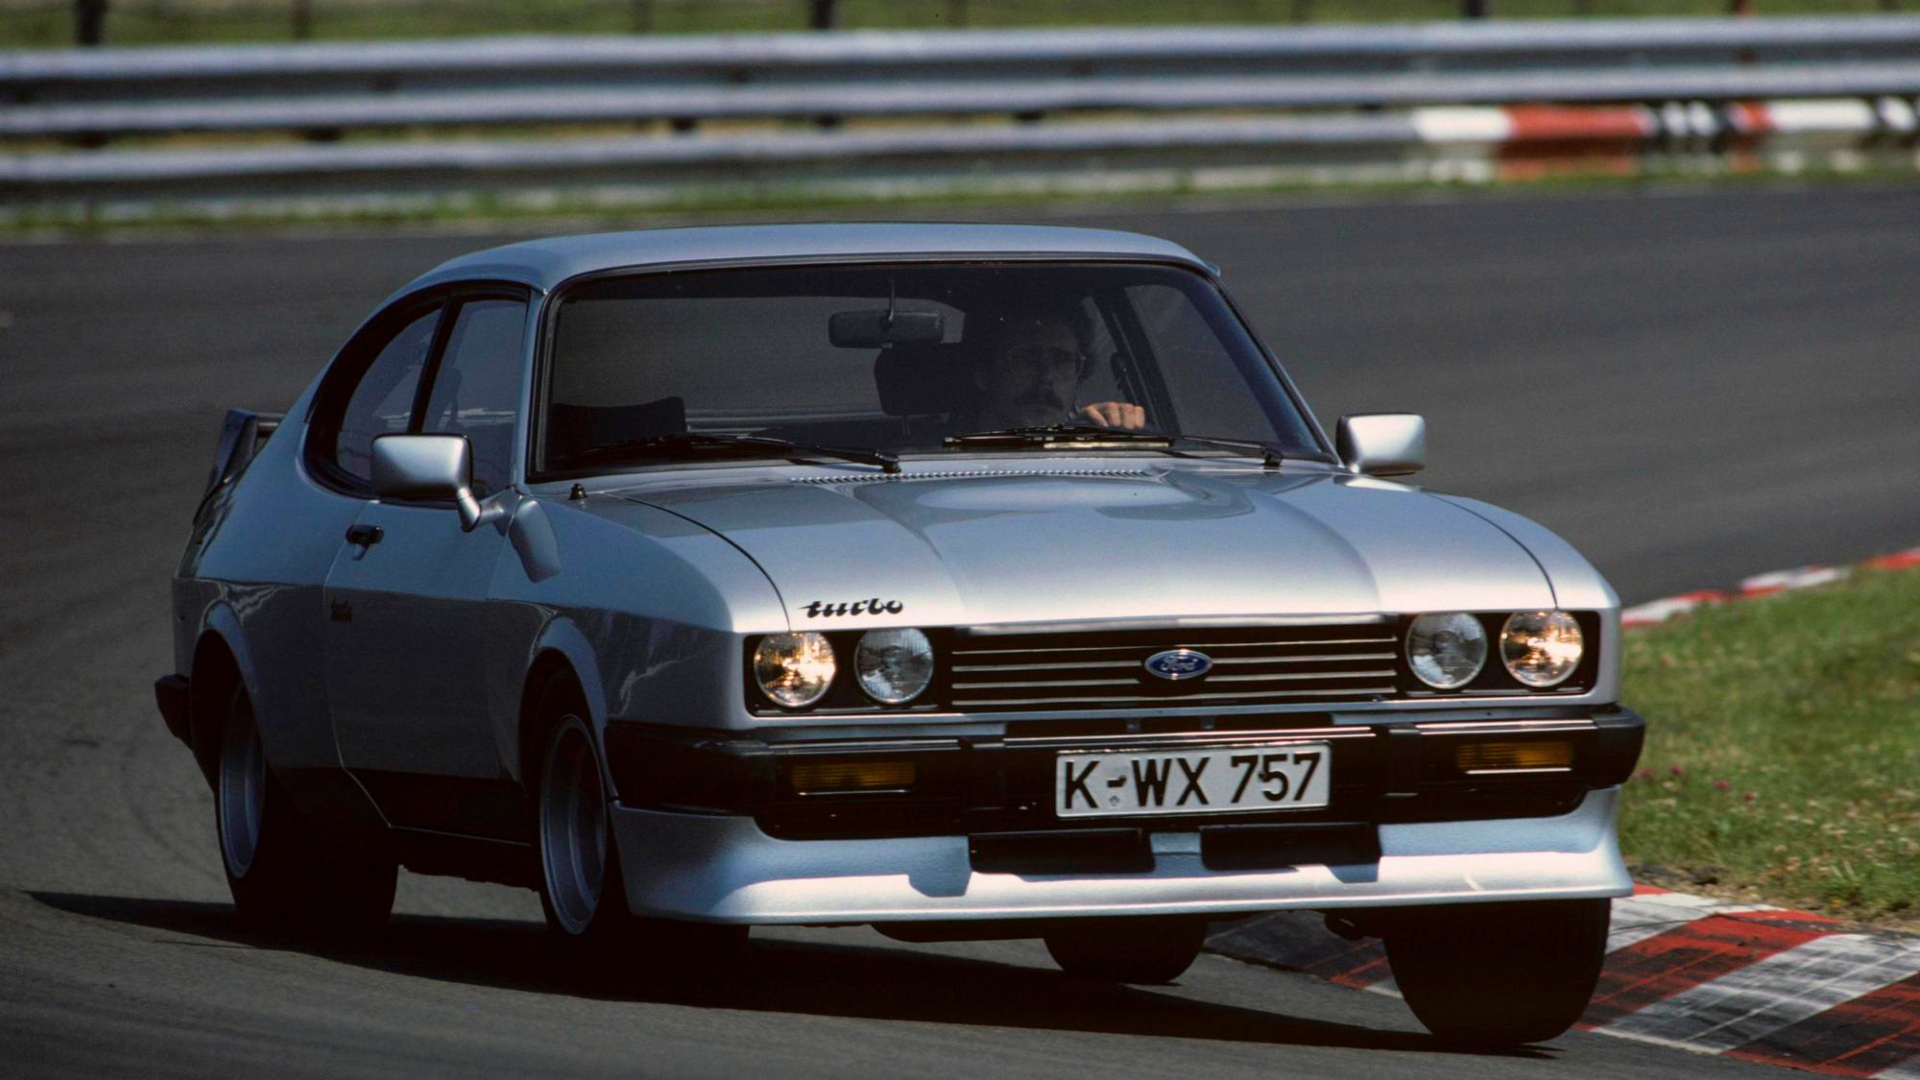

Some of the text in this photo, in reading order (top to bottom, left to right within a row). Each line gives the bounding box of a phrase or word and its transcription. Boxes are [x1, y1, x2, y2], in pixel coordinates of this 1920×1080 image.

[798, 598, 904, 618] turbo
[1160, 654, 1199, 671] Ford
[1230, 752, 1322, 804] 757
